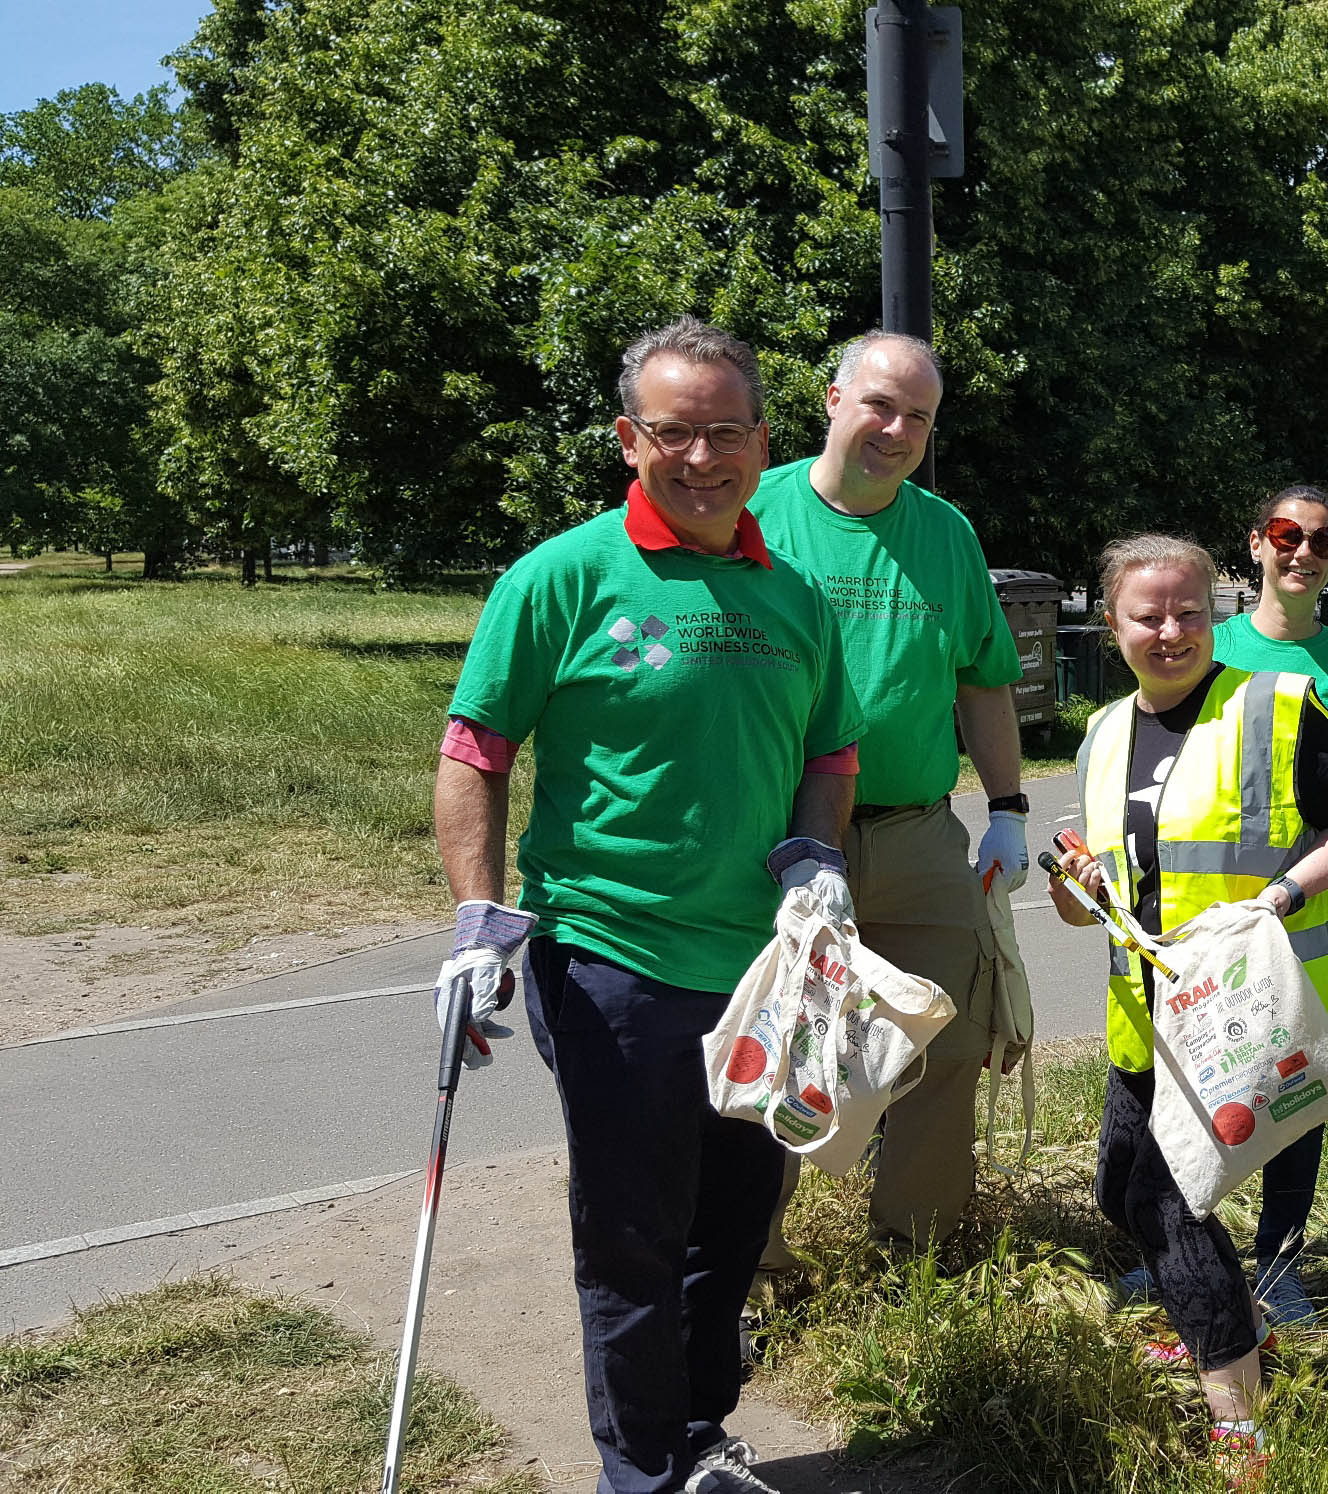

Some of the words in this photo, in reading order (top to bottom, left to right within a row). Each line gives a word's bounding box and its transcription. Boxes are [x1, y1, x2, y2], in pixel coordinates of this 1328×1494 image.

[827, 575, 889, 587] MARRIOTT
[828, 586, 905, 599] WORLDWIDE
[829, 598, 887, 610] BUSINESS
[888, 600, 944, 613] COUNCILS
[675, 612, 752, 625] MARRIOTT
[677, 626, 769, 641] WORLDWIDE
[679, 641, 750, 654] BUSINESS
[751, 642, 801, 664] COUNCILS
[1253, 975, 1275, 994] GUIDE
[1166, 976, 1219, 1015] TRAIL
[1192, 991, 1221, 1013] magazine
[1185, 1030, 1208, 1048] Camping
[1188, 1033, 1217, 1055] Caravanning
[1234, 1041, 1253, 1055] KEEP
[1236, 1042, 1265, 1060] BRITAIN
[1191, 1051, 1203, 1062] Club
